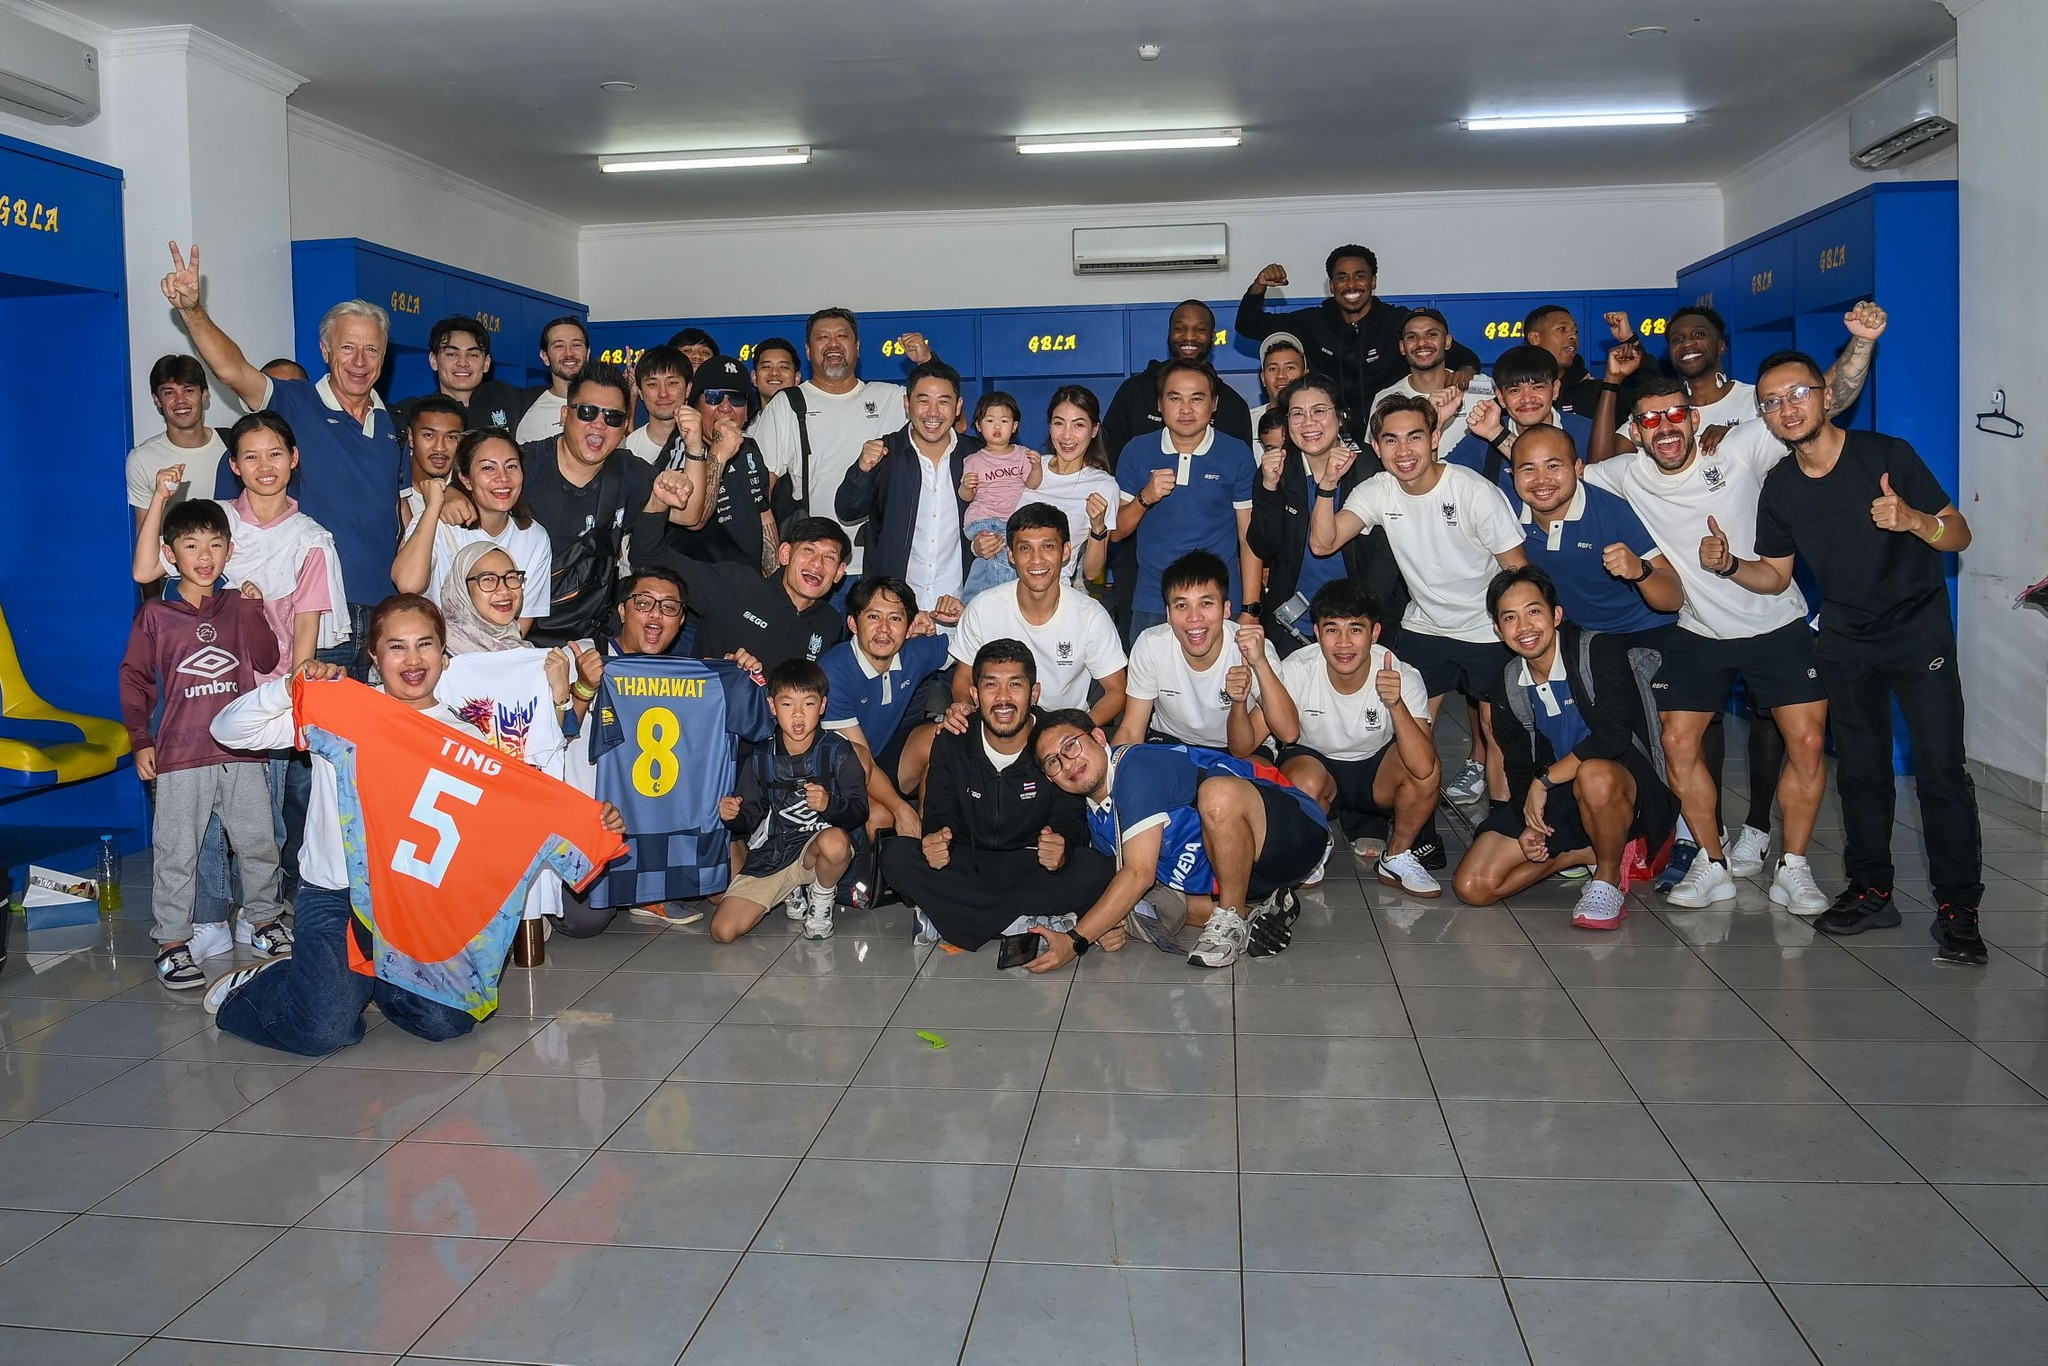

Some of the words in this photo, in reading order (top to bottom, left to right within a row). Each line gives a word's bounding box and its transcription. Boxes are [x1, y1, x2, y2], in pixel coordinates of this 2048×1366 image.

[1819, 244, 1846, 273] GBLA
[391, 290, 420, 314] GBLA
[1484, 321, 1525, 340] GBL
[1028, 335, 1077, 353] GBLA
[613, 676, 706, 698] THANAWAT
[1564, 698, 1575, 706] RB
[420, 736, 504, 777] TING
[631, 706, 681, 798] 8
[390, 767, 484, 889] 5
